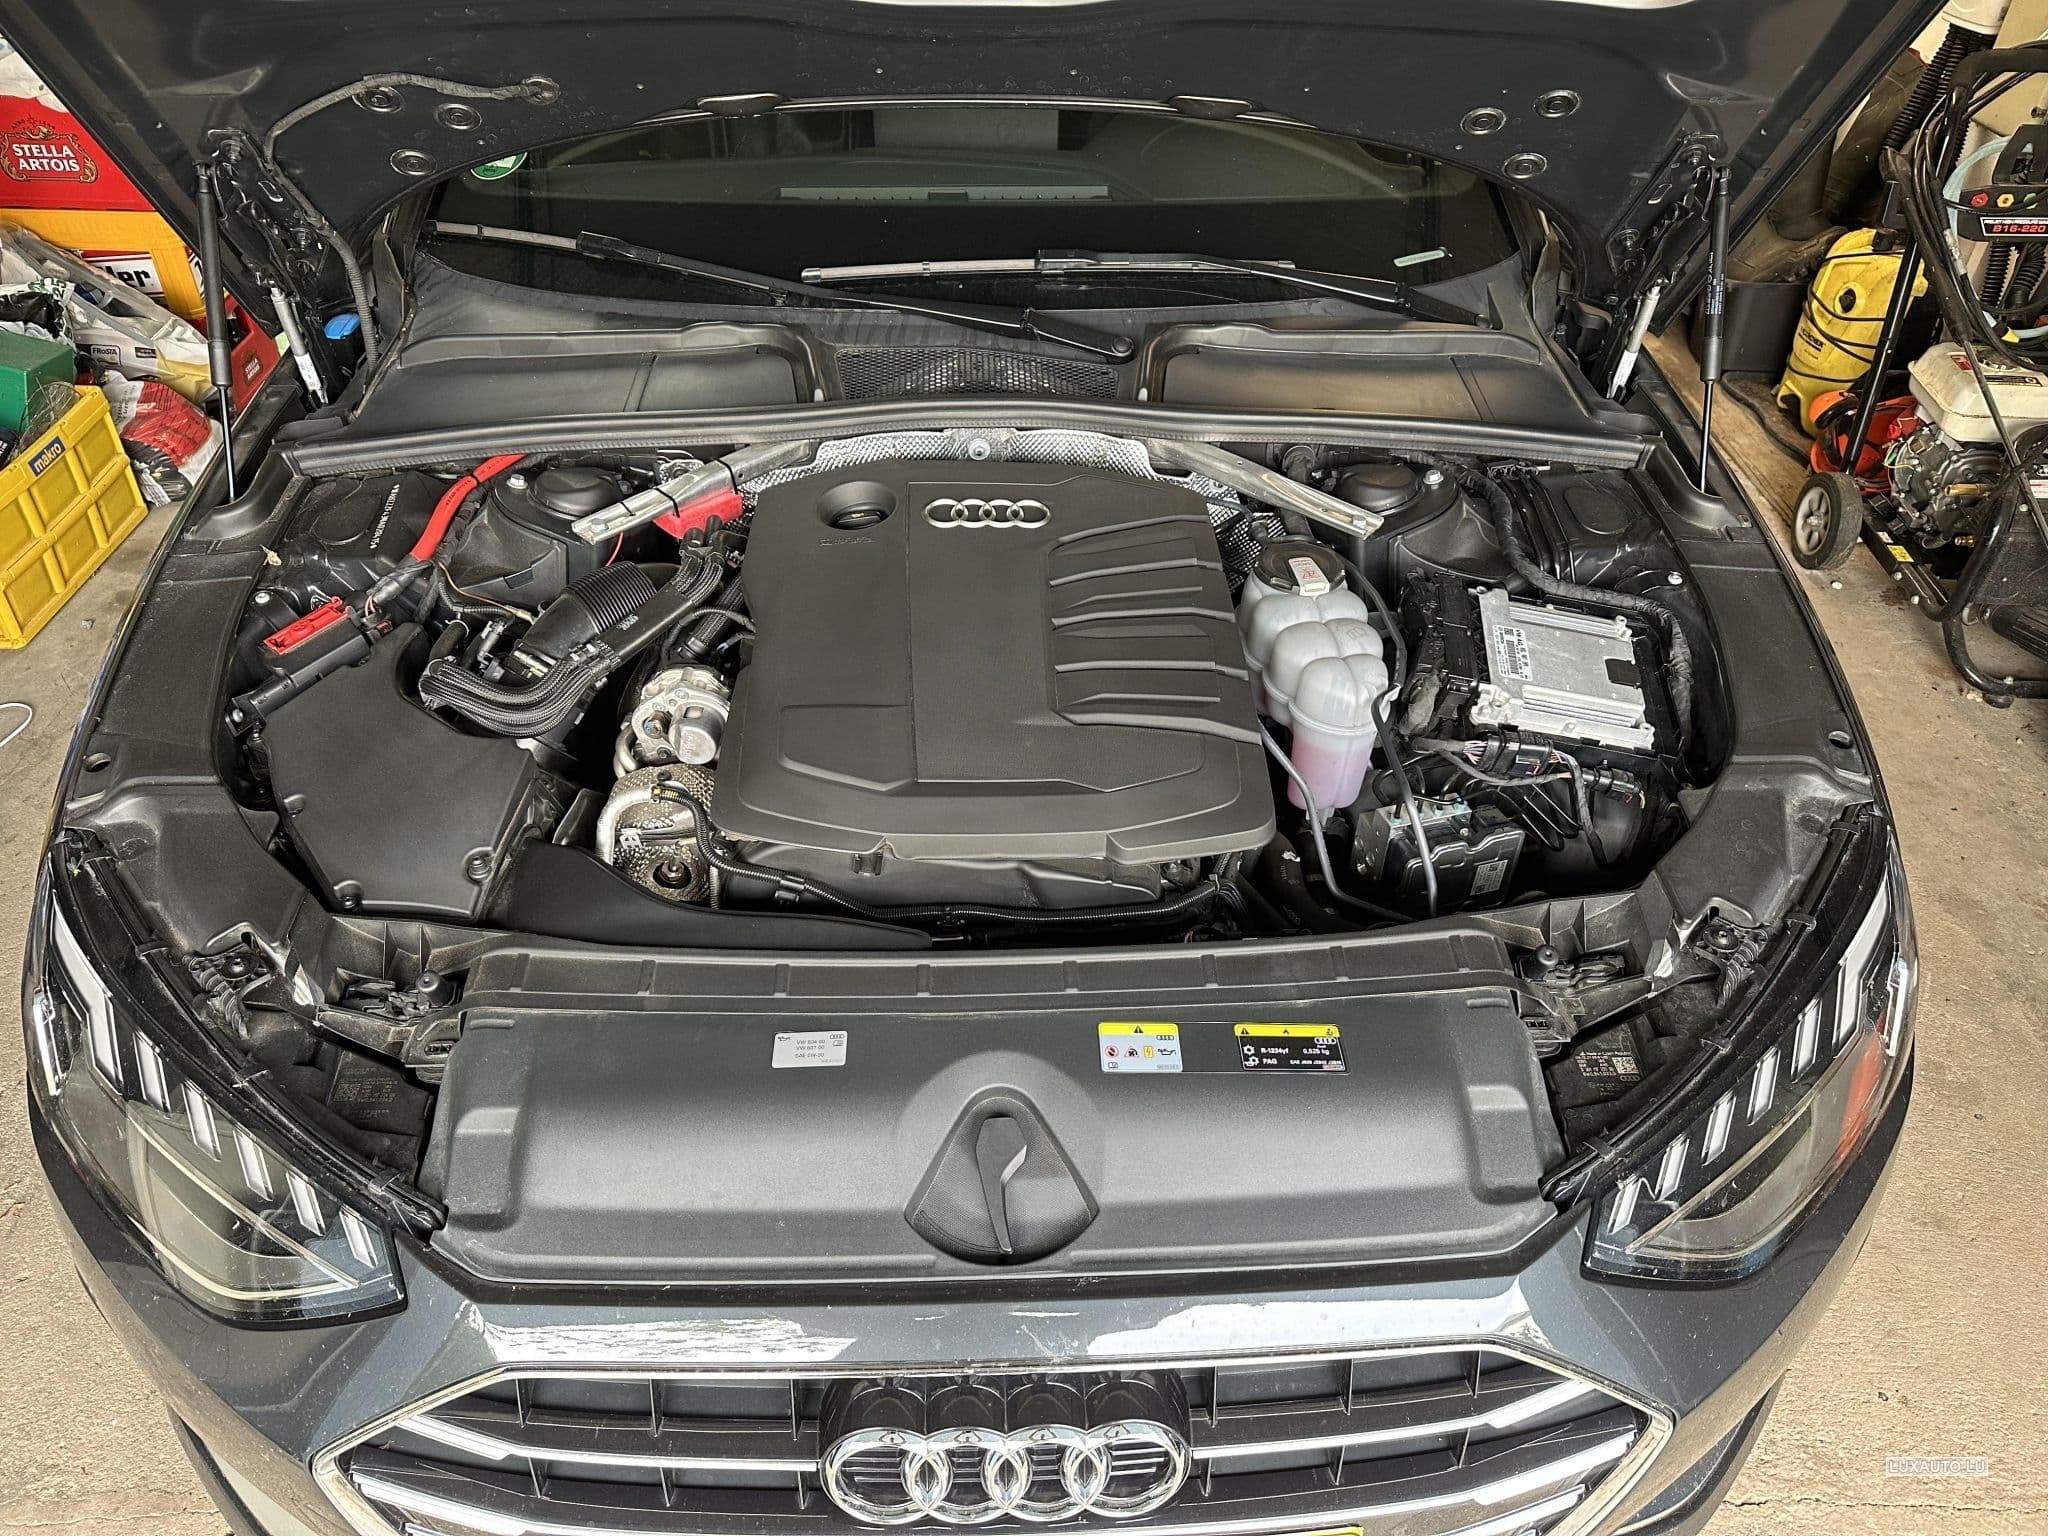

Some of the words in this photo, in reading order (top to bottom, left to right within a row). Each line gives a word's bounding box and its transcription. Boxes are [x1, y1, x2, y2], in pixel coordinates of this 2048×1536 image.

[12, 144, 75, 158] STELLA
[19, 158, 80, 172] ARTOIS
[33, 442, 62, 473] makro
